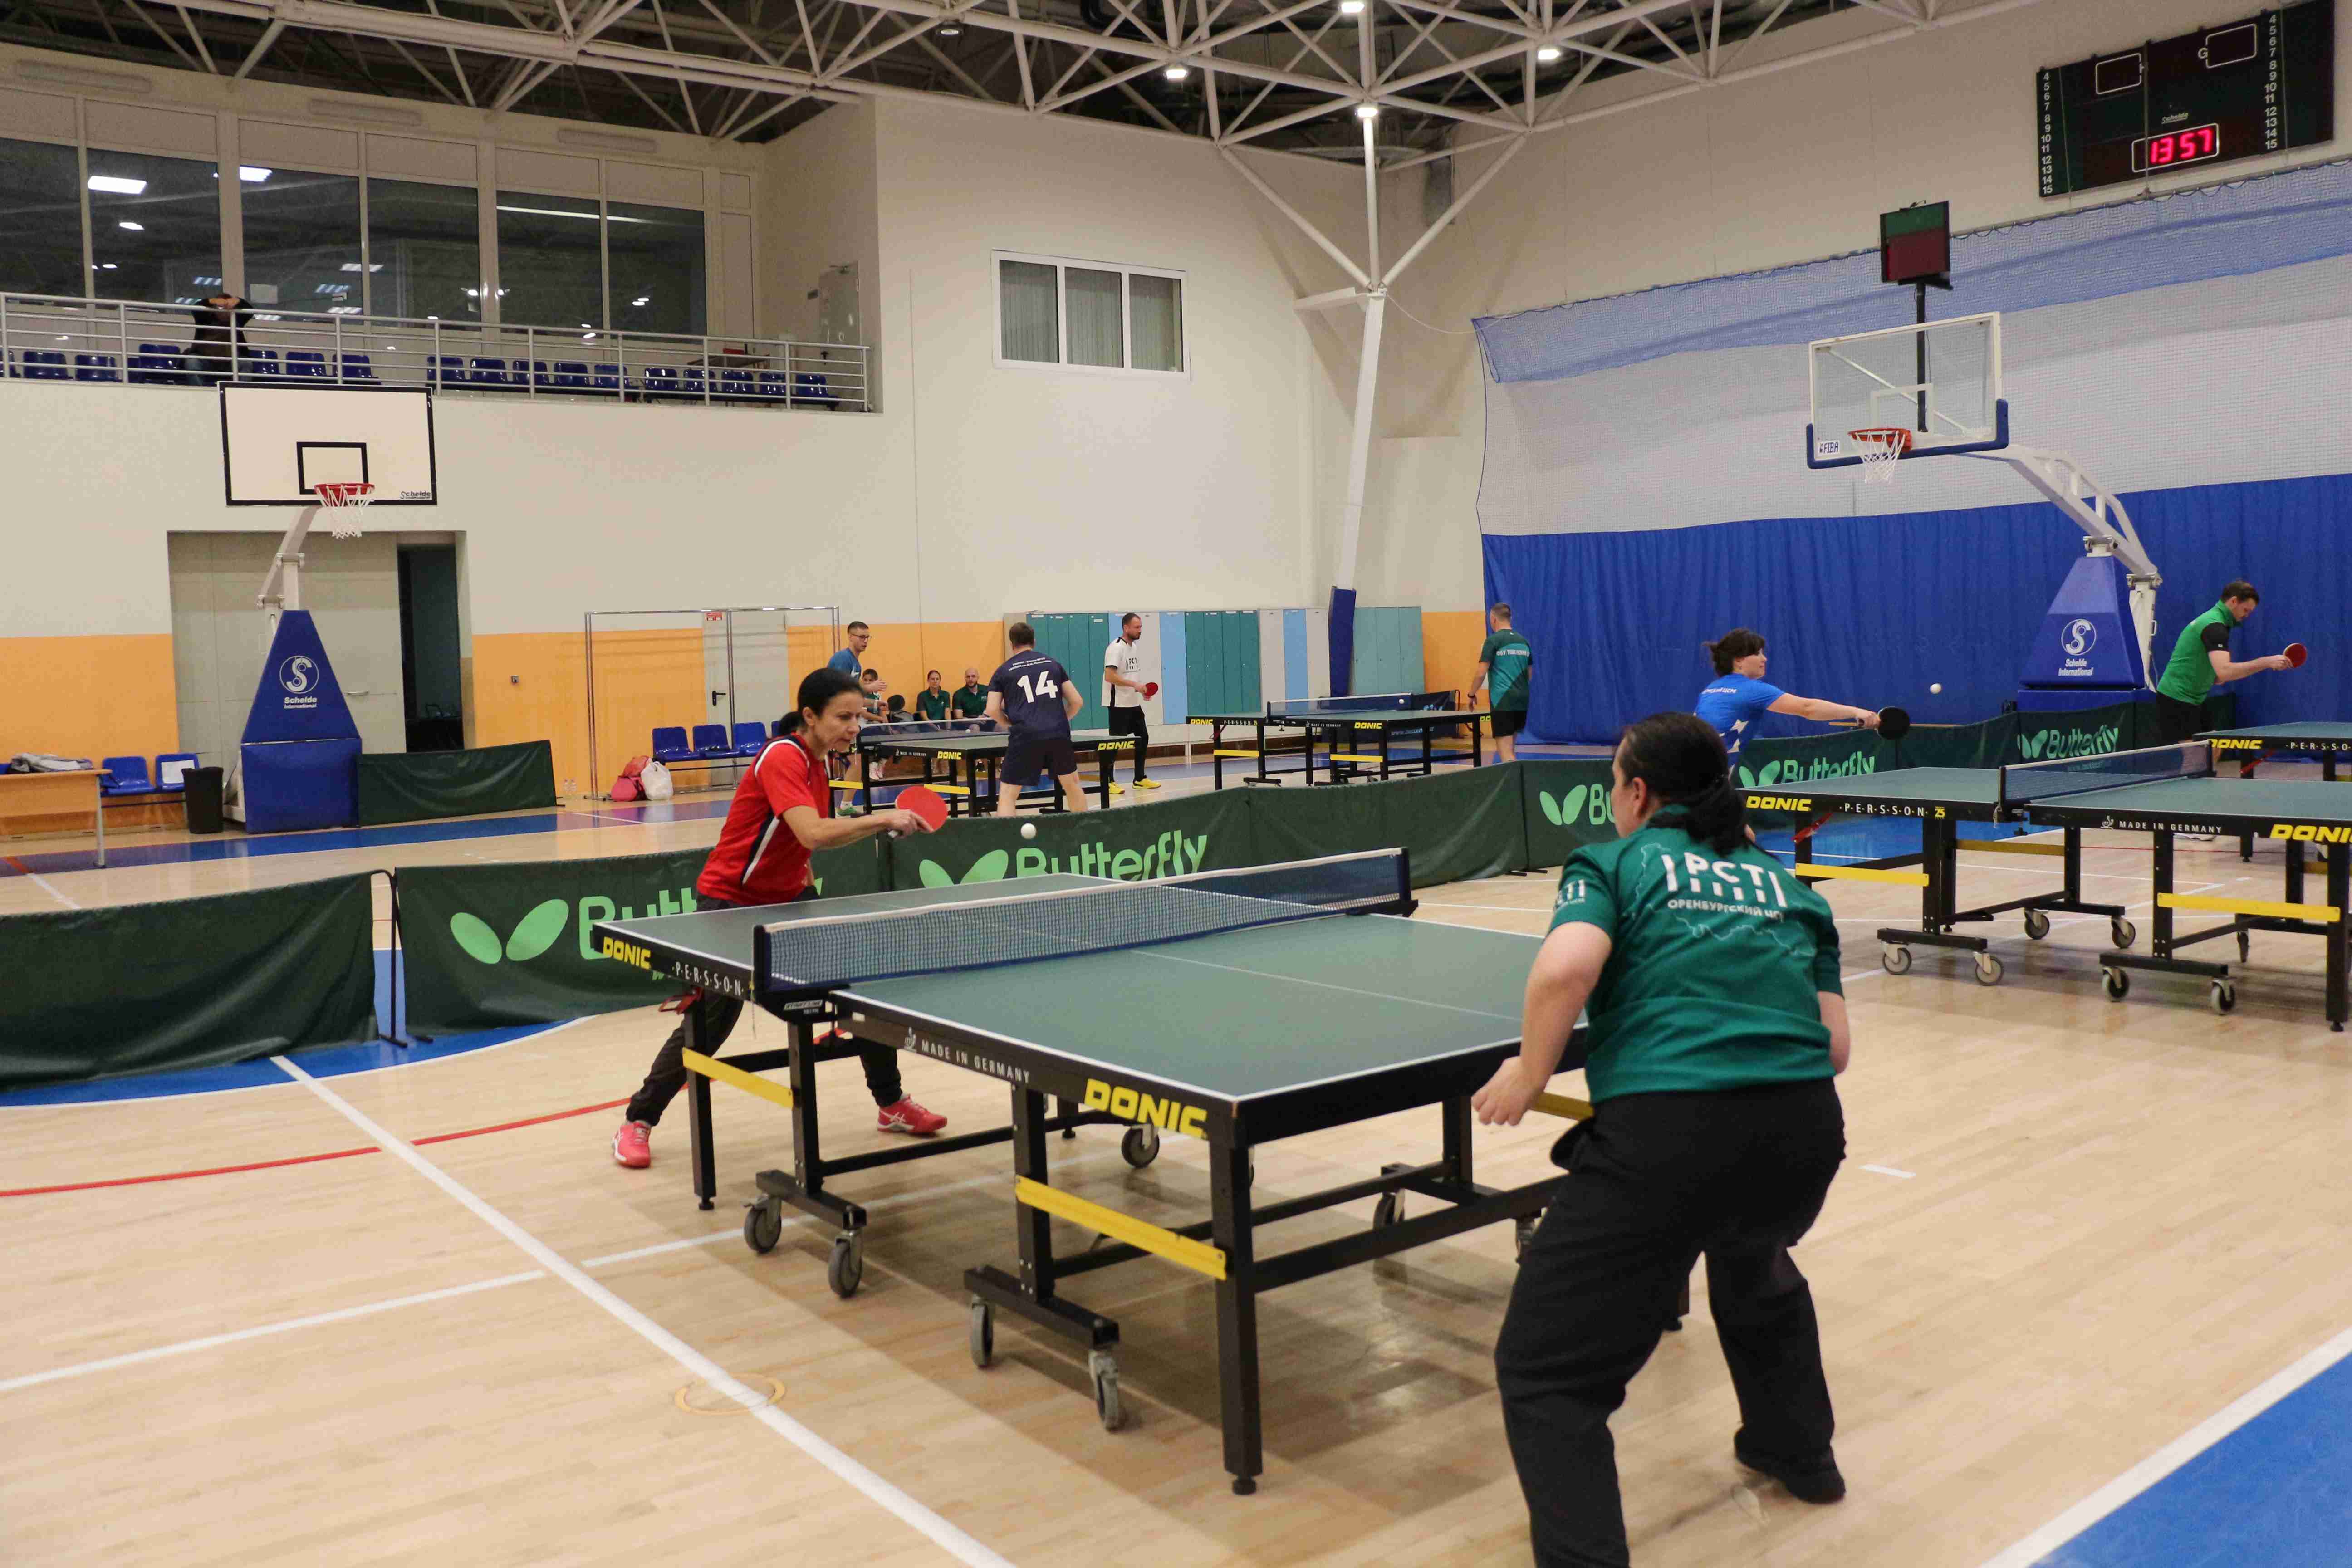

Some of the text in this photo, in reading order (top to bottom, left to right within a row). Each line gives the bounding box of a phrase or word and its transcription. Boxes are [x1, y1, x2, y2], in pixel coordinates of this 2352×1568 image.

[2269, 15, 2276, 24] 4
[2269, 26, 2276, 35] 5
[2269, 37, 2276, 46] 6
[2269, 48, 2276, 57] 7
[2269, 60, 2276, 69] 8
[2269, 71, 2276, 81] 9
[2043, 83, 2050, 91] 5
[2264, 82, 2277, 92] 10
[2044, 92, 2050, 100] 6
[2264, 93, 2274, 103] 11
[2044, 102, 2050, 110] 7
[2264, 106, 2277, 117] 12
[2044, 114, 2050, 122] 8
[2265, 117, 2277, 127] 13
[2045, 124, 2051, 132] 9
[2265, 128, 2277, 138] 14
[2041, 134, 2051, 143] 10
[2041, 143, 2049, 153] 11
[2265, 139, 2278, 149] 15
[2042, 155, 2052, 164] 12
[2042, 165, 2052, 174] 13
[2043, 175, 2052, 184] 14
[2043, 185, 2053, 194] 15
[1824, 442, 1838, 453] FIBA
[2065, 658, 2087, 667] Schelde
[1017, 671, 1058, 703] 14
[1098, 740, 1135, 751] DONIC
[937, 751, 962, 760] DONIC
[1745, 795, 1812, 812] DONIC
[1934, 808, 1945, 817] 25
[2119, 821, 2147, 829] MADE
[2171, 823, 2222, 834] GERMANY
[2270, 824, 2352, 843] DONI
[1667, 898, 1763, 916] ОРЕНБУРГСКИЙ
[603, 936, 652, 970] DONIC
[921, 1039, 1208, 1140] MADE IN GERMANY DONIC
